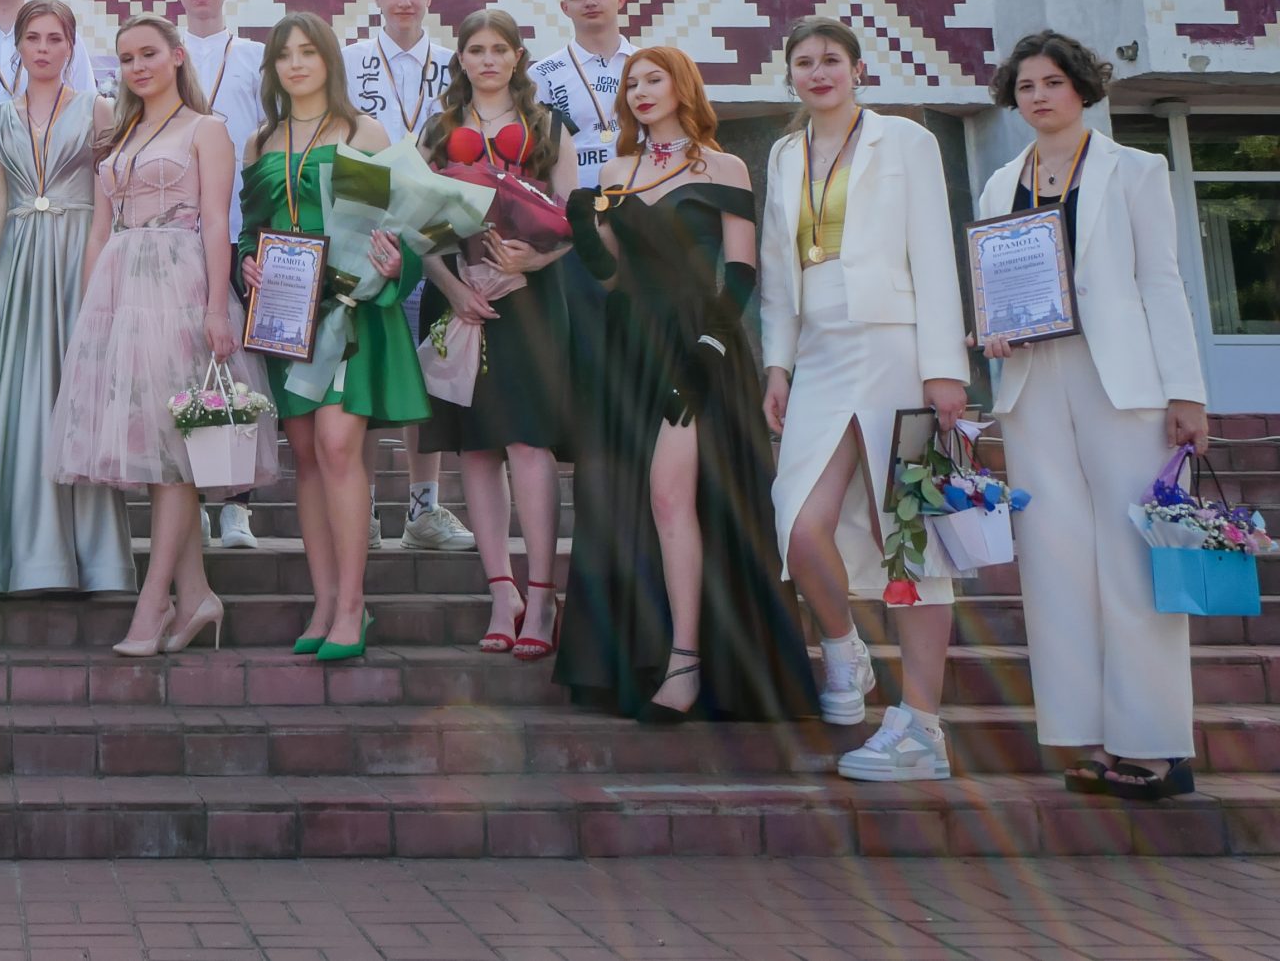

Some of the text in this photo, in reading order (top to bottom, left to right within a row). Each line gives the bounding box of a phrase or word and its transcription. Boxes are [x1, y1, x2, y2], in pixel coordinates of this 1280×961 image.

[577, 149, 609, 166] URE
[992, 237, 1039, 253] ГРАМОТА
[273, 256, 306, 267] ГРАМОТА
